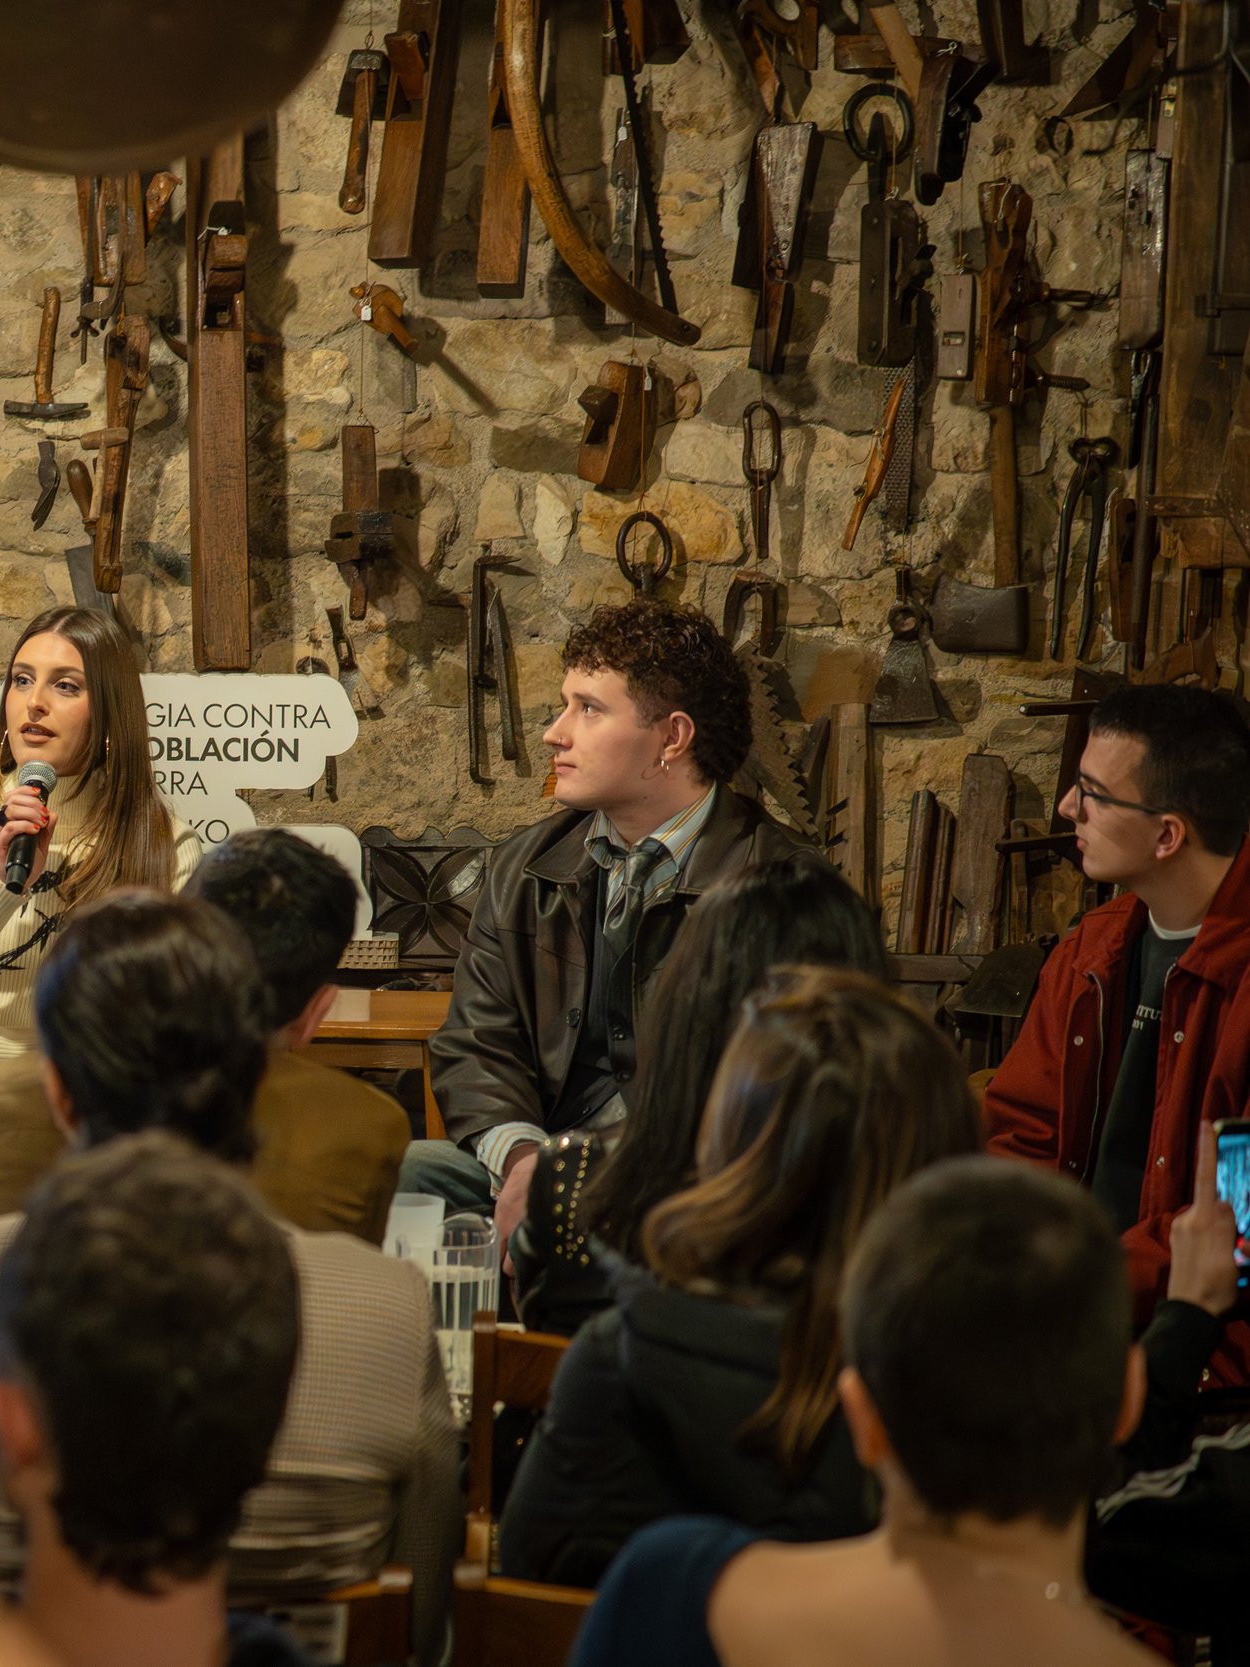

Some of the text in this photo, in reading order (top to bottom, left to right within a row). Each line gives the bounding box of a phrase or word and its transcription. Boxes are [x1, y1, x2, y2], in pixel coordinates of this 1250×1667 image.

[145, 702, 331, 729] GIA CONTRA
[148, 730, 300, 763] OBLACIÓN
